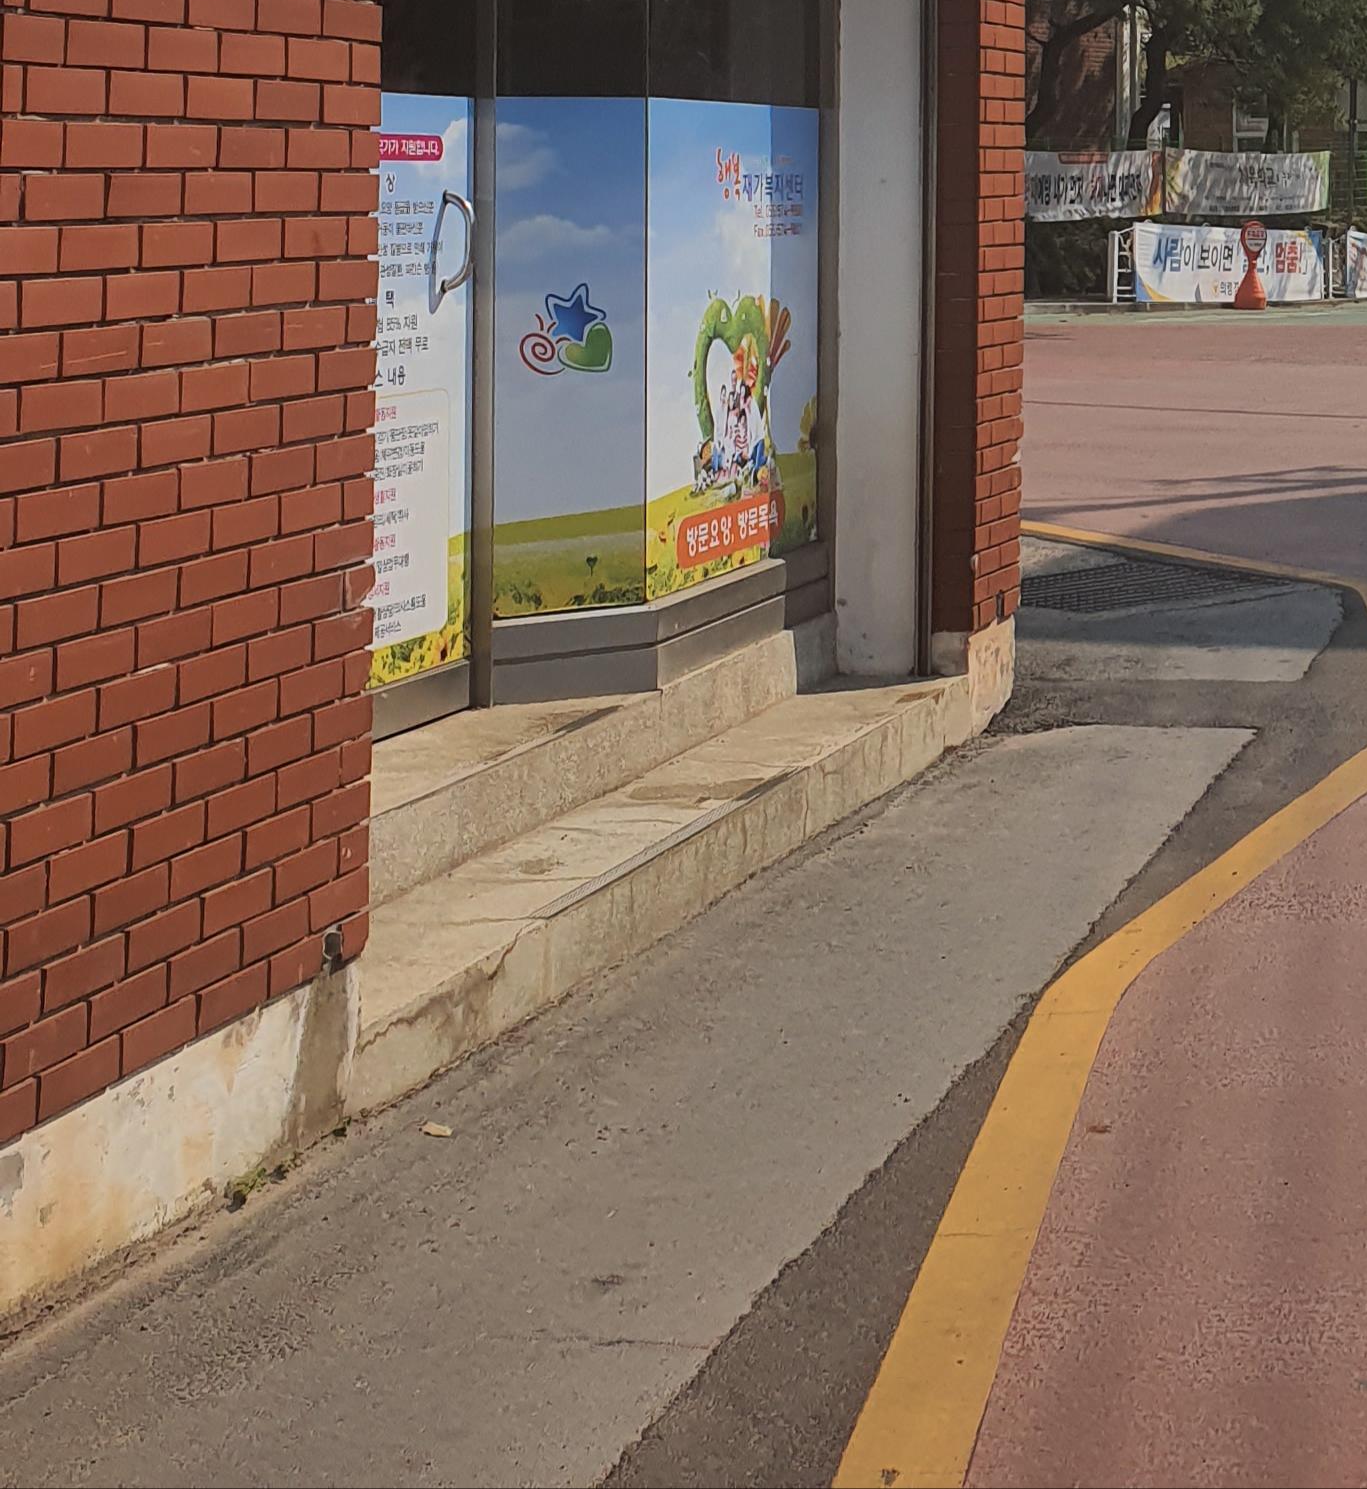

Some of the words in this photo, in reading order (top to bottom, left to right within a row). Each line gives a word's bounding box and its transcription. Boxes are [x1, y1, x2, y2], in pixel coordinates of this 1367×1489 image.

[716, 148, 741, 200] 행복
[742, 173, 804, 203] 재가복지센터
[1152, 238, 1195, 273] 사람이
[1197, 243, 1234, 272] 보이면
[387, 365, 406, 386] 내용
[686, 515, 735, 558] 방문요양,
[737, 499, 779, 540] 방문목욕
